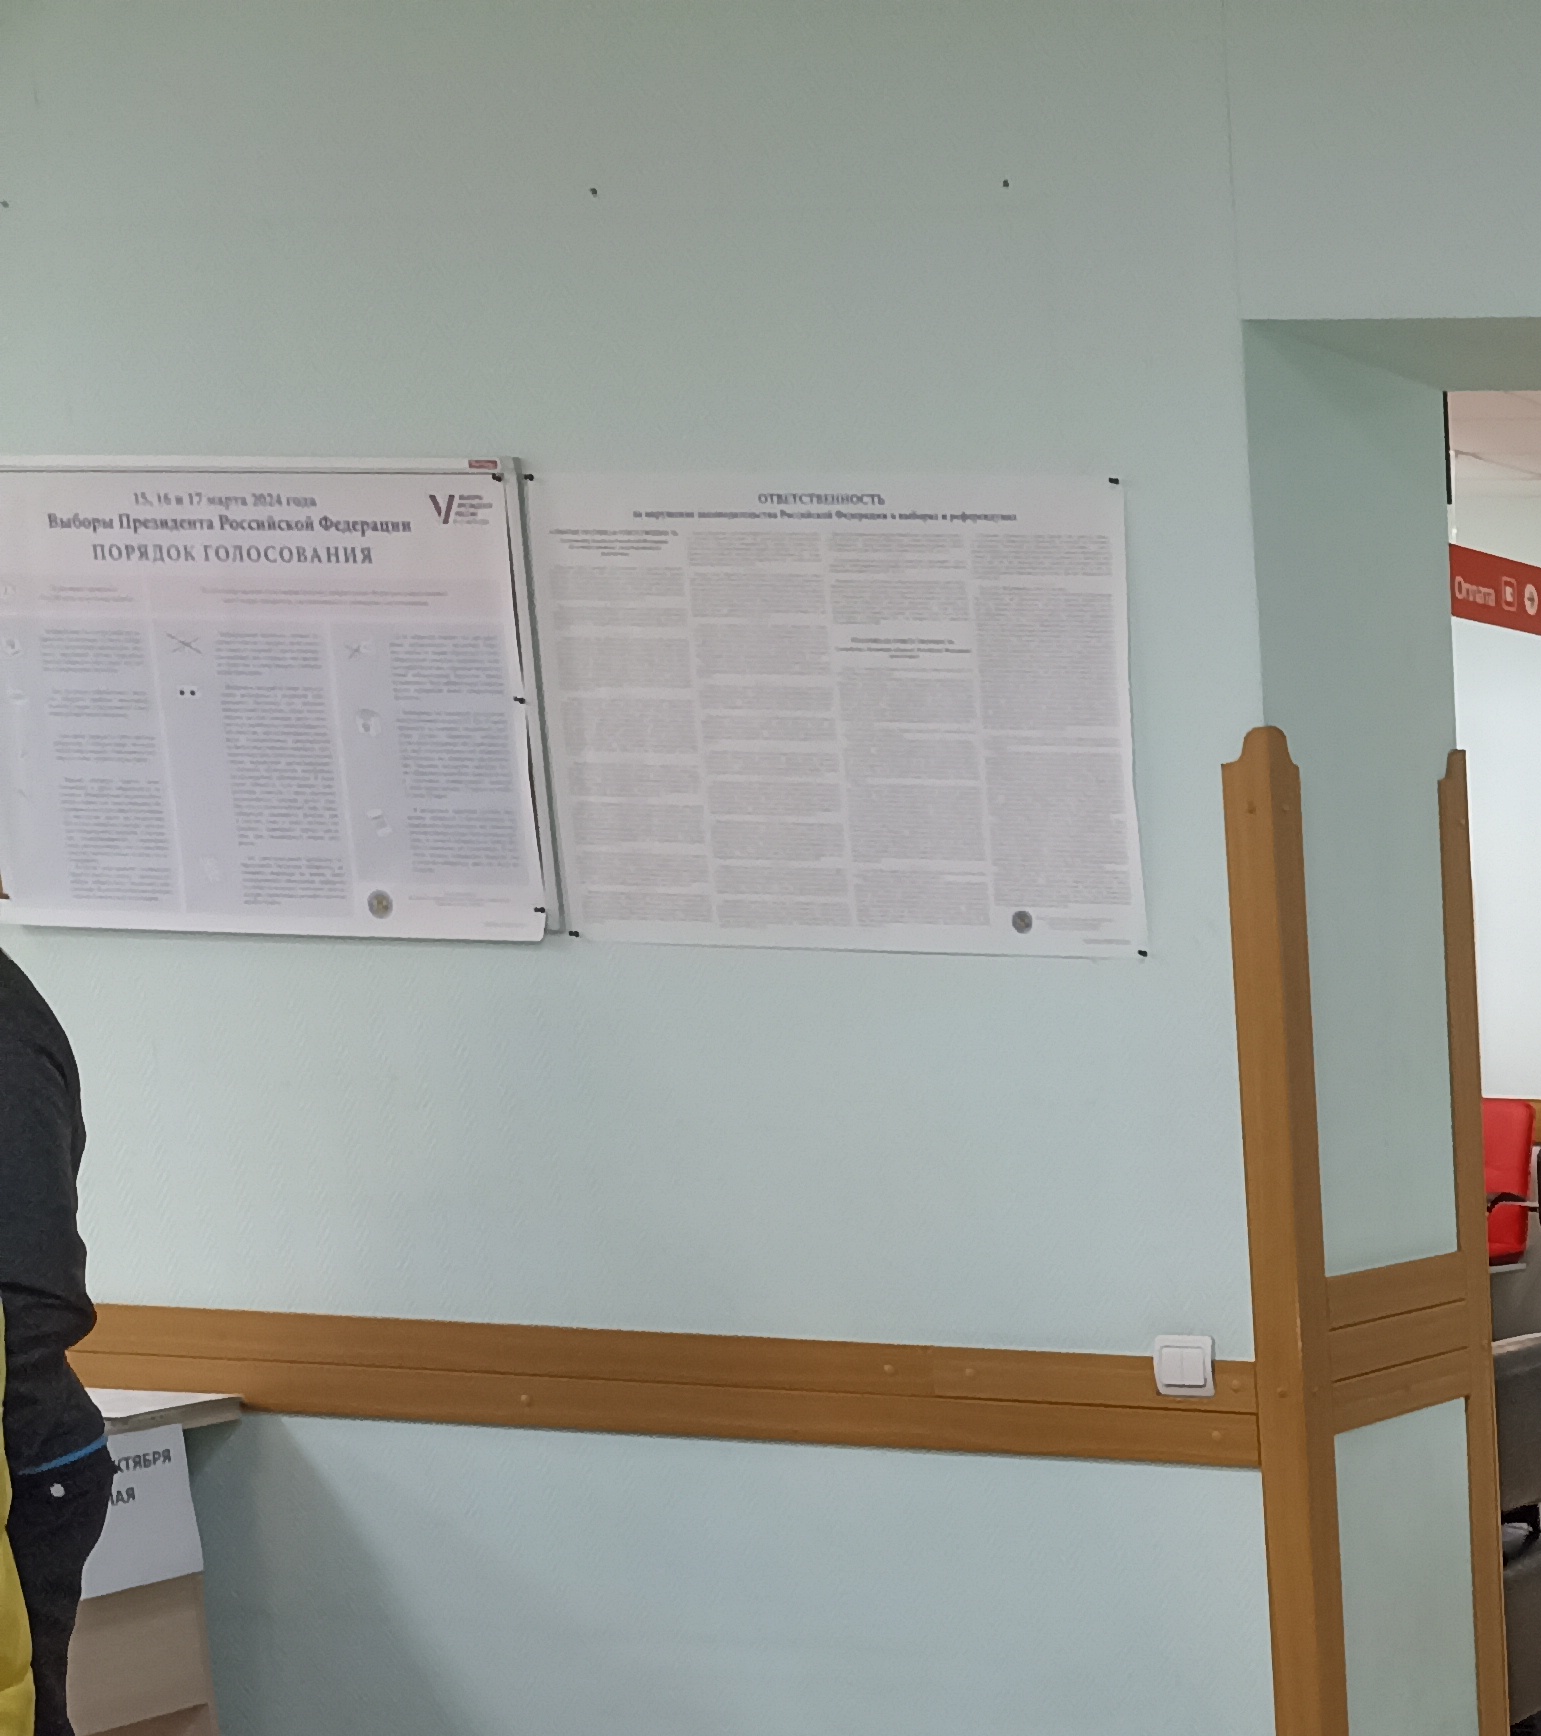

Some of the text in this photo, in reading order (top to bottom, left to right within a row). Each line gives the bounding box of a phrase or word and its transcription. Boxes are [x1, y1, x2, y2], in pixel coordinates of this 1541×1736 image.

[187, 492, 203, 506] 17
[251, 492, 283, 507] 2024
[47, 512, 412, 537] Выборы Президента Российской Федерации
[92, 543, 374, 565] ПОРЯДОК ГОЛОСОВАНИЯ
